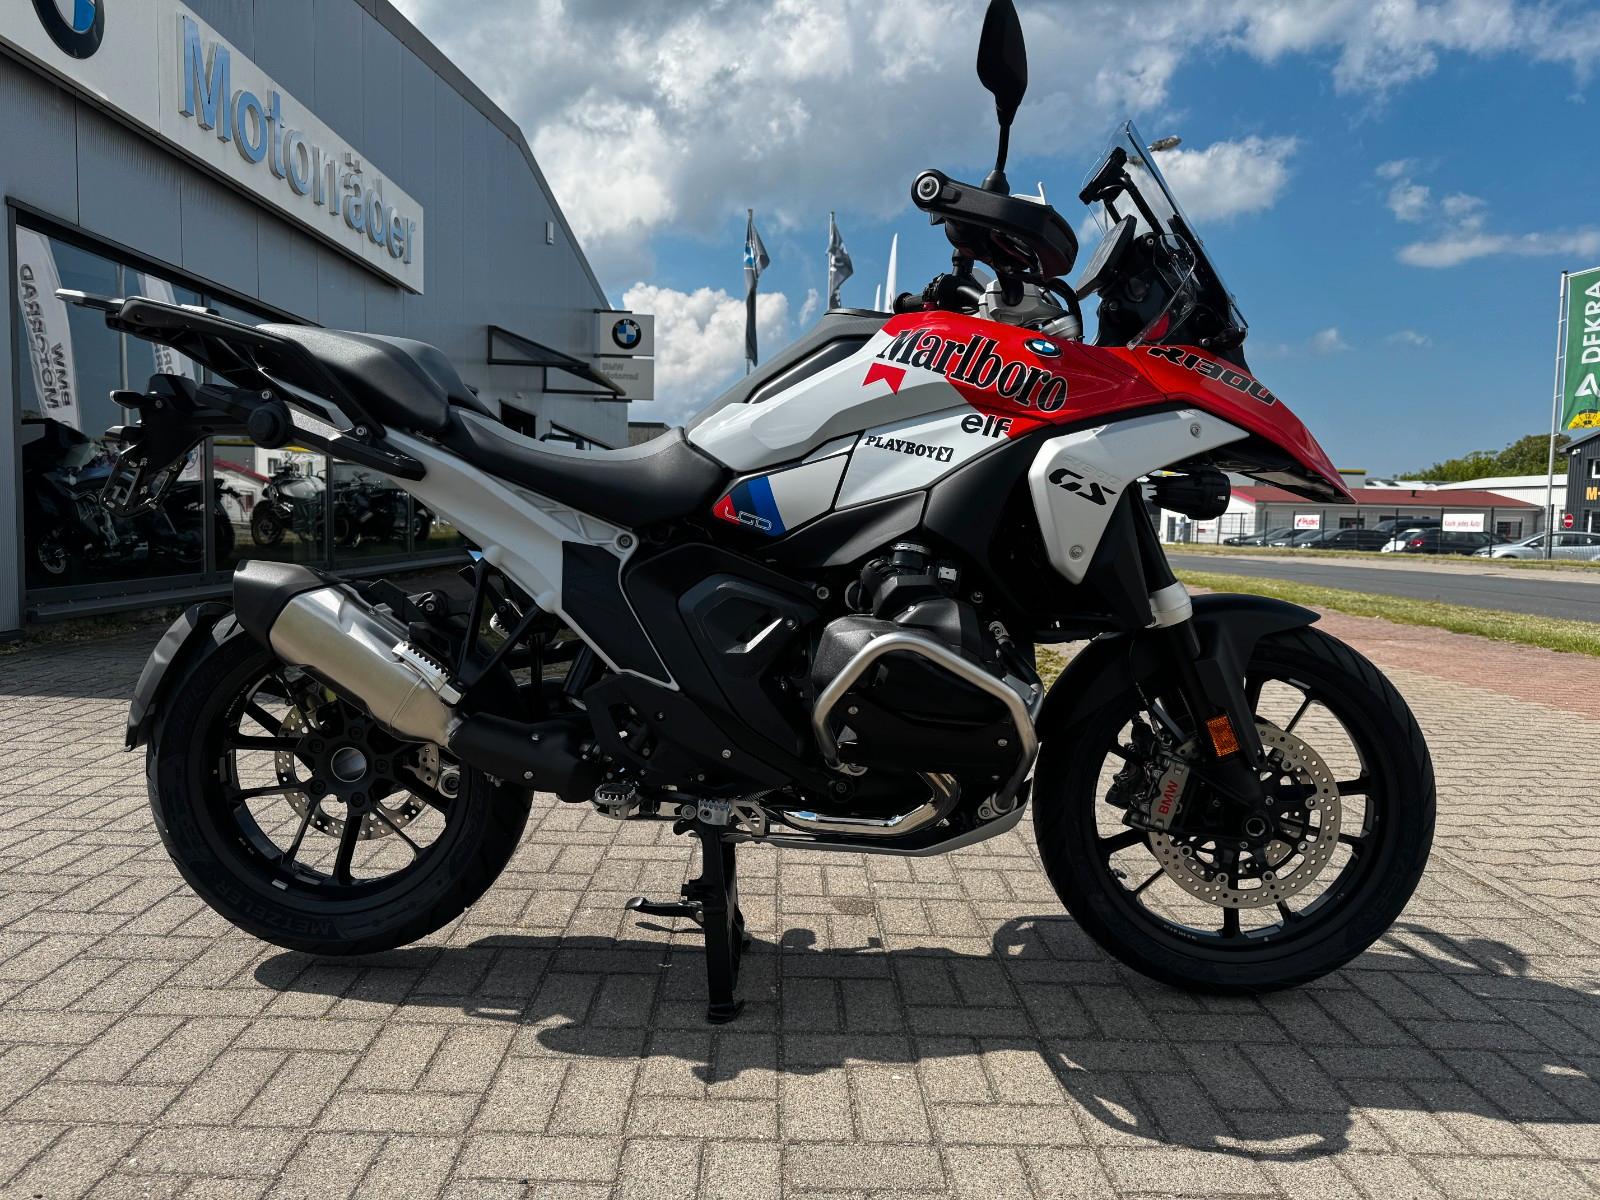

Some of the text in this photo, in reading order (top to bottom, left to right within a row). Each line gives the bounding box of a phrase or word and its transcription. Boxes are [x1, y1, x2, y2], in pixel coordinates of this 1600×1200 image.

[176, 12, 416, 265] Motorräder
[876, 327, 1068, 413] Marlboro
[960, 413, 1013, 439] elf
[865, 435, 940, 460] PLAYBOY
[1048, 468, 1117, 506] GS
[1158, 780, 1178, 815] BMW
